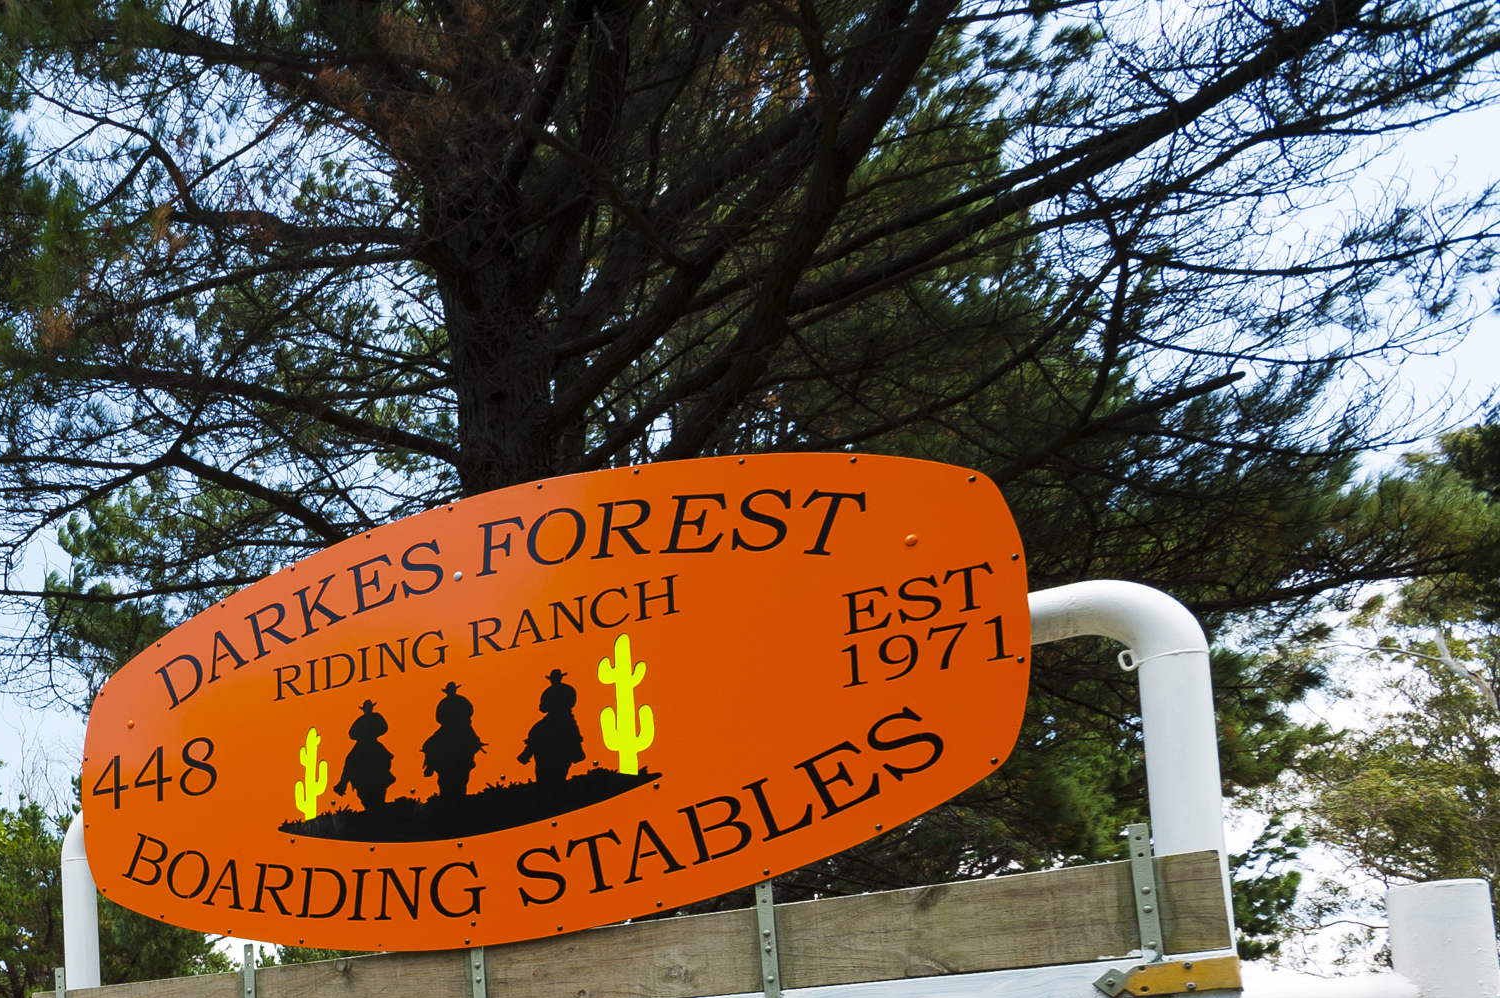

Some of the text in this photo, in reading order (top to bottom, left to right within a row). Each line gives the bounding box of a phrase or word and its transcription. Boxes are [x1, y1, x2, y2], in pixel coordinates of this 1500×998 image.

[154, 488, 866, 711] DARKES FOREST
[272, 573, 680, 702] RIDING RANCH
[841, 561, 994, 636] EST
[840, 614, 1015, 689] 1971
[90, 737, 218, 810] 448
[121, 706, 944, 921] BOARDING STABLES
